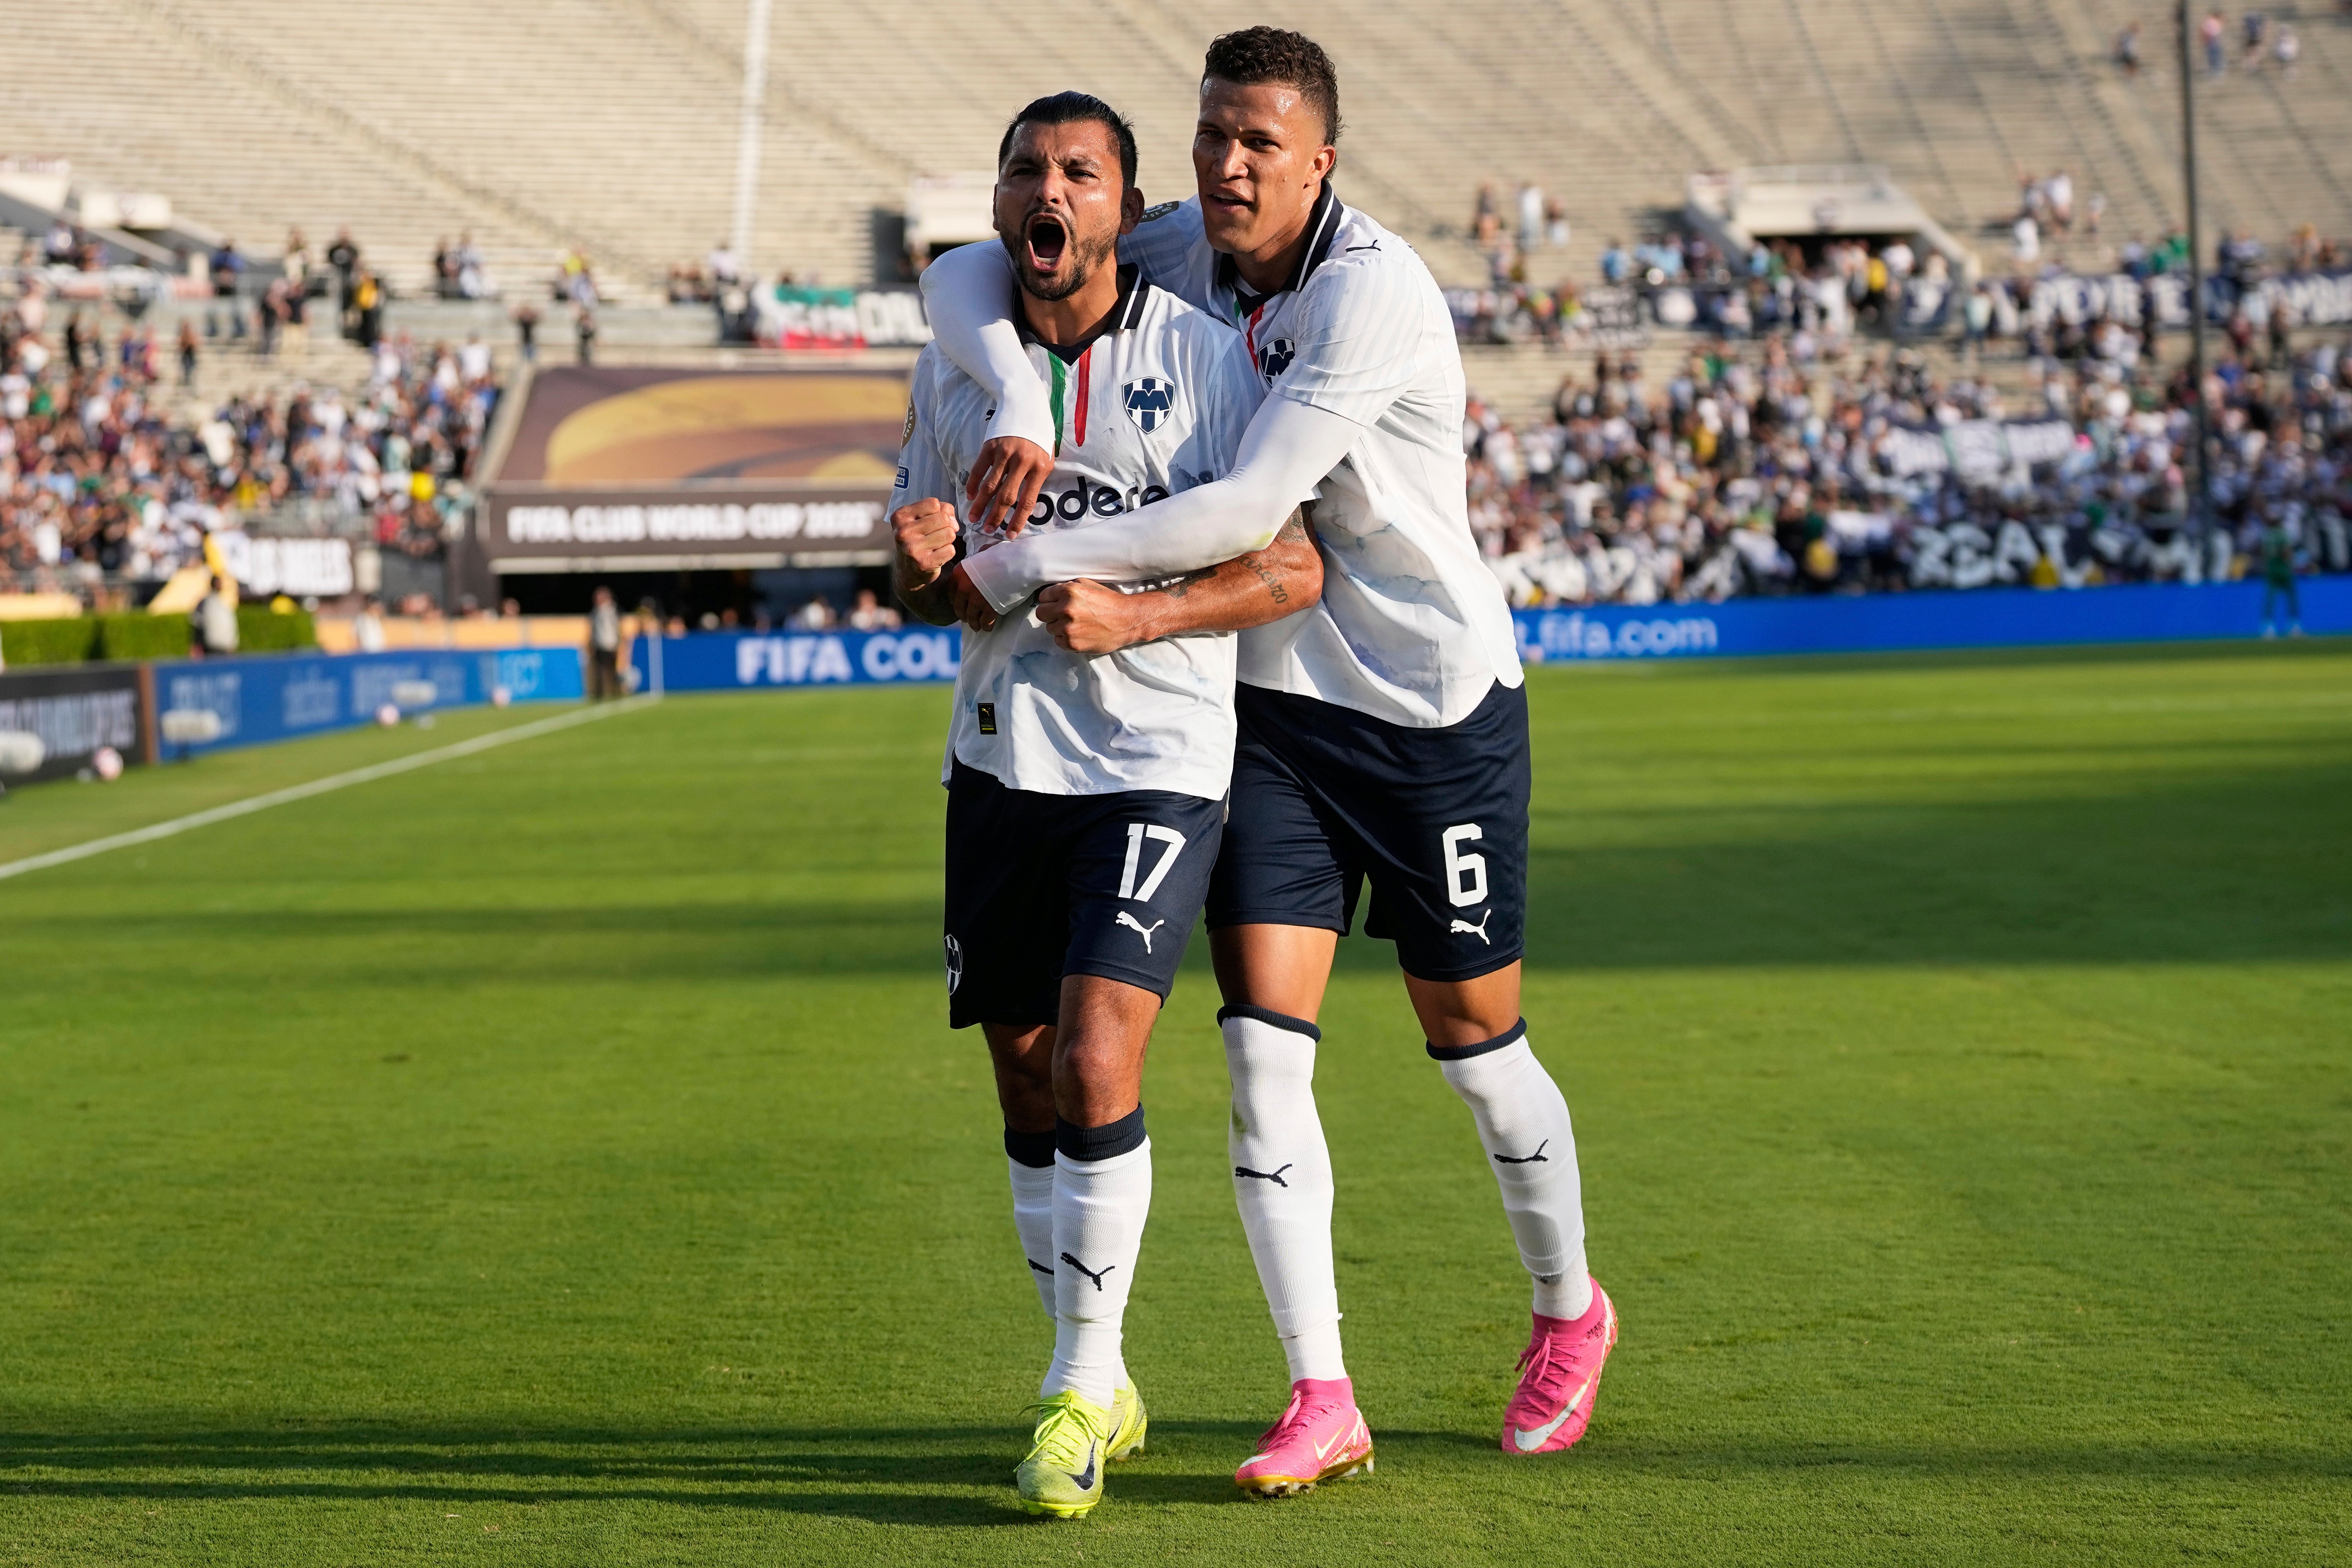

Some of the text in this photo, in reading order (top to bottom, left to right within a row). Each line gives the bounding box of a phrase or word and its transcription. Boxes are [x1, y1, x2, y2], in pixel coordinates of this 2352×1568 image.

[909, 410, 913, 420] 25
[507, 506, 572, 543] FIFA
[573, 505, 645, 543] CLUB
[646, 504, 746, 540] WORLD
[747, 502, 803, 539] CUP
[736, 634, 853, 683] FIFA
[1118, 823, 1187, 902] 17
[1442, 823, 1488, 908] 6
